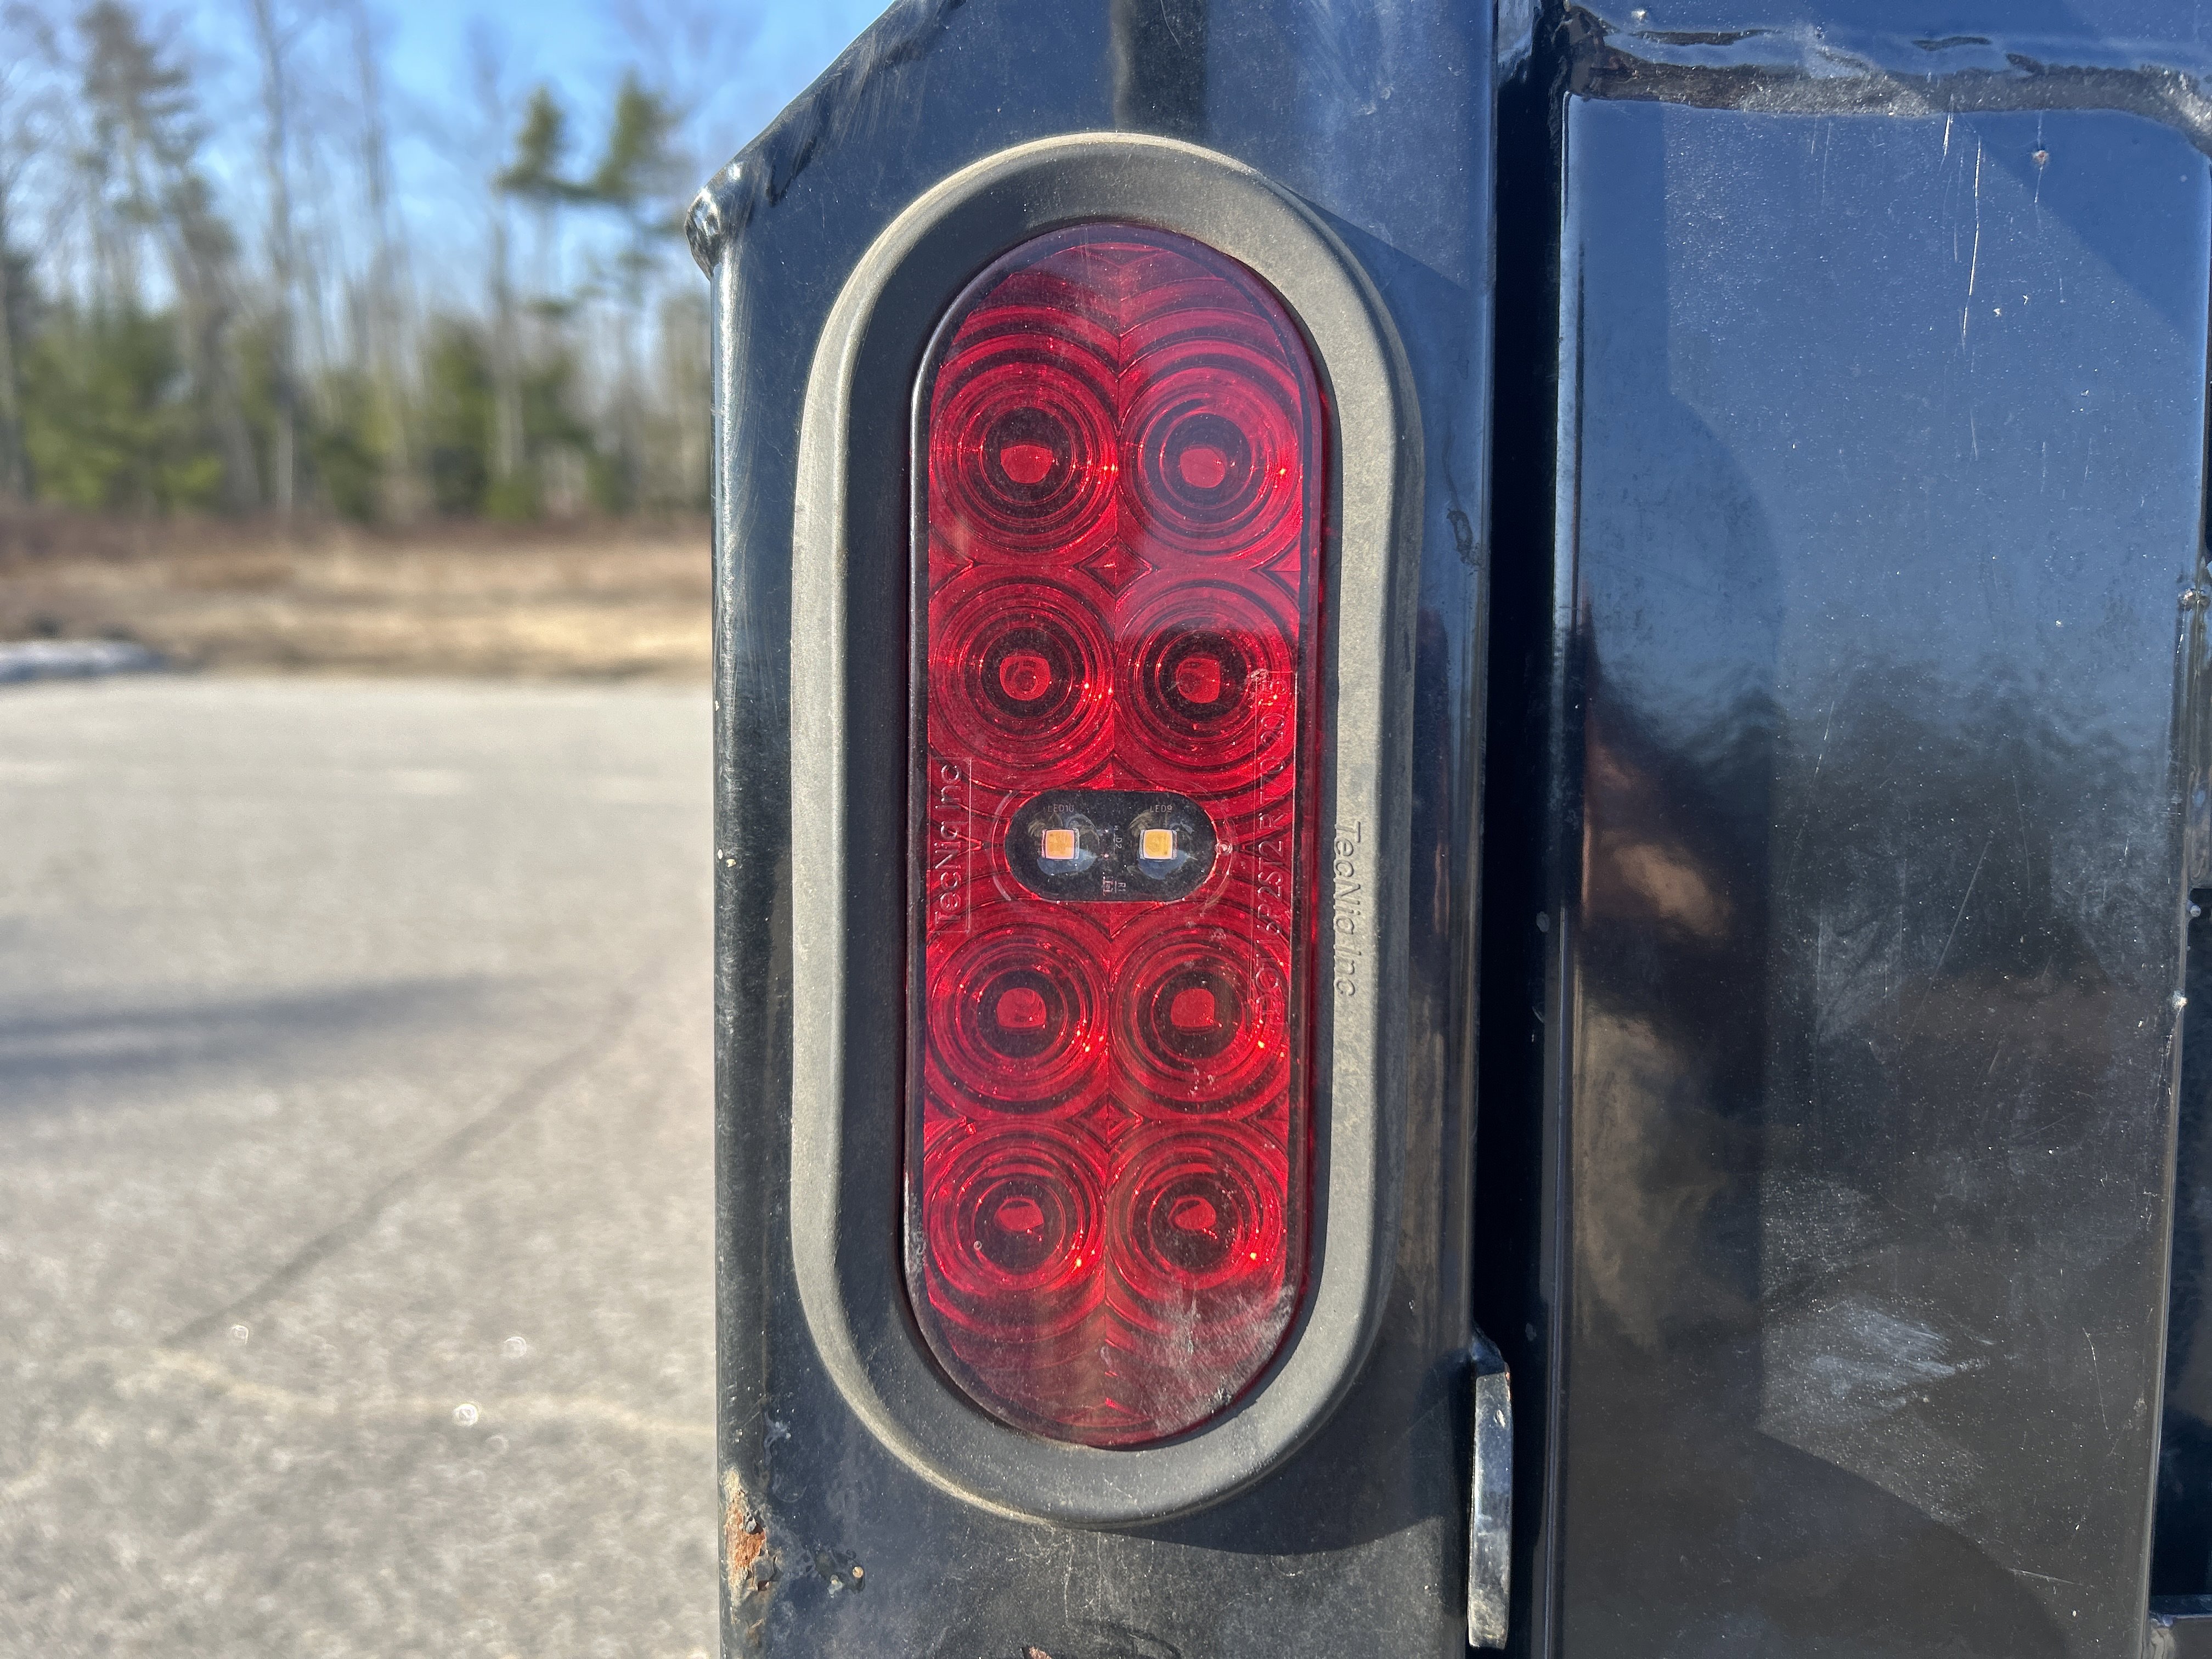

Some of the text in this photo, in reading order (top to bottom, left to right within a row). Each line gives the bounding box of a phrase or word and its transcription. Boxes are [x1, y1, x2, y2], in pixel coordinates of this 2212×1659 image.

[1047, 803, 1074, 812] LED10
[1149, 804, 1173, 813] LED9
[933, 764, 968, 925] TecNiq Inc
[1334, 944, 1362, 996] Inc
